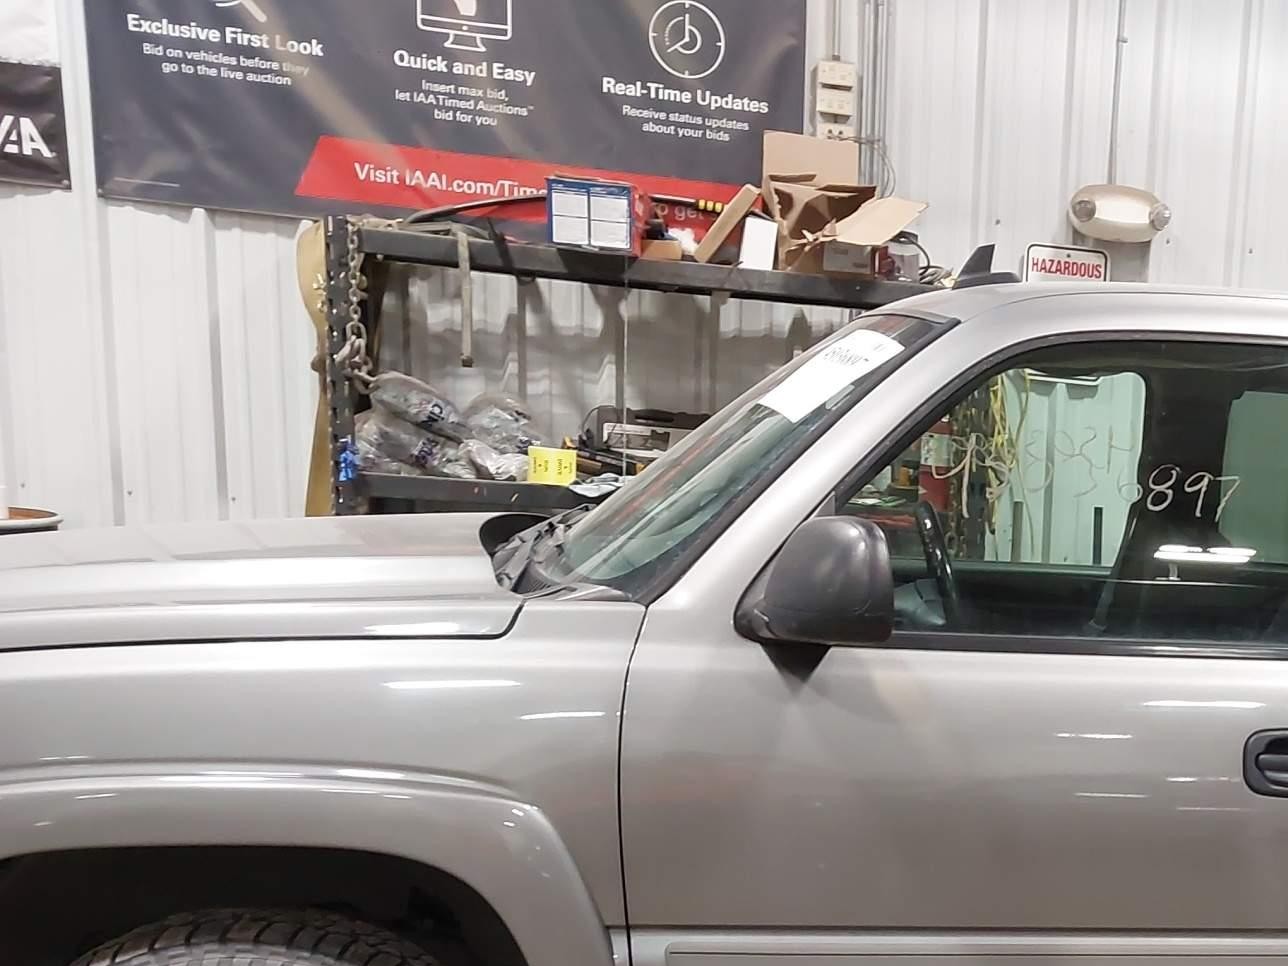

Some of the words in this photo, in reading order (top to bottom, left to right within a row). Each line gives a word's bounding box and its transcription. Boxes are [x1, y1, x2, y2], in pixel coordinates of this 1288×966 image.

[126, 13, 221, 43] Exclusive
[225, 26, 270, 49] First
[275, 34, 324, 57] Look
[143, 42, 164, 56] Bid
[166, 48, 183, 59] on
[185, 50, 237, 66] vehicles
[240, 55, 280, 71] before
[282, 62, 310, 76] they
[393, 49, 448, 73] Quick
[452, 61, 487, 77] and
[492, 62, 536, 87] Easy
[161, 61, 179, 74] go
[181, 62, 194, 74] to
[197, 65, 218, 77] the
[220, 67, 244, 80] live
[246, 72, 291, 86] auction
[395, 89, 410, 102] let
[421, 79, 455, 94] Insert
[458, 86, 483, 97] max
[602, 76, 692, 104] Real-Time
[696, 89, 769, 114] Updates
[434, 108, 453, 121] bid
[456, 112, 473, 123] for
[475, 115, 497, 127] you
[622, 105, 667, 120] Receive
[668, 111, 702, 125] status
[705, 116, 750, 131] updates
[642, 121, 675, 135] about
[677, 127, 703, 139] your
[706, 129, 730, 142] bids
[354, 161, 400, 186] Visit
[1031, 257, 1102, 279] HAZARDOUS
